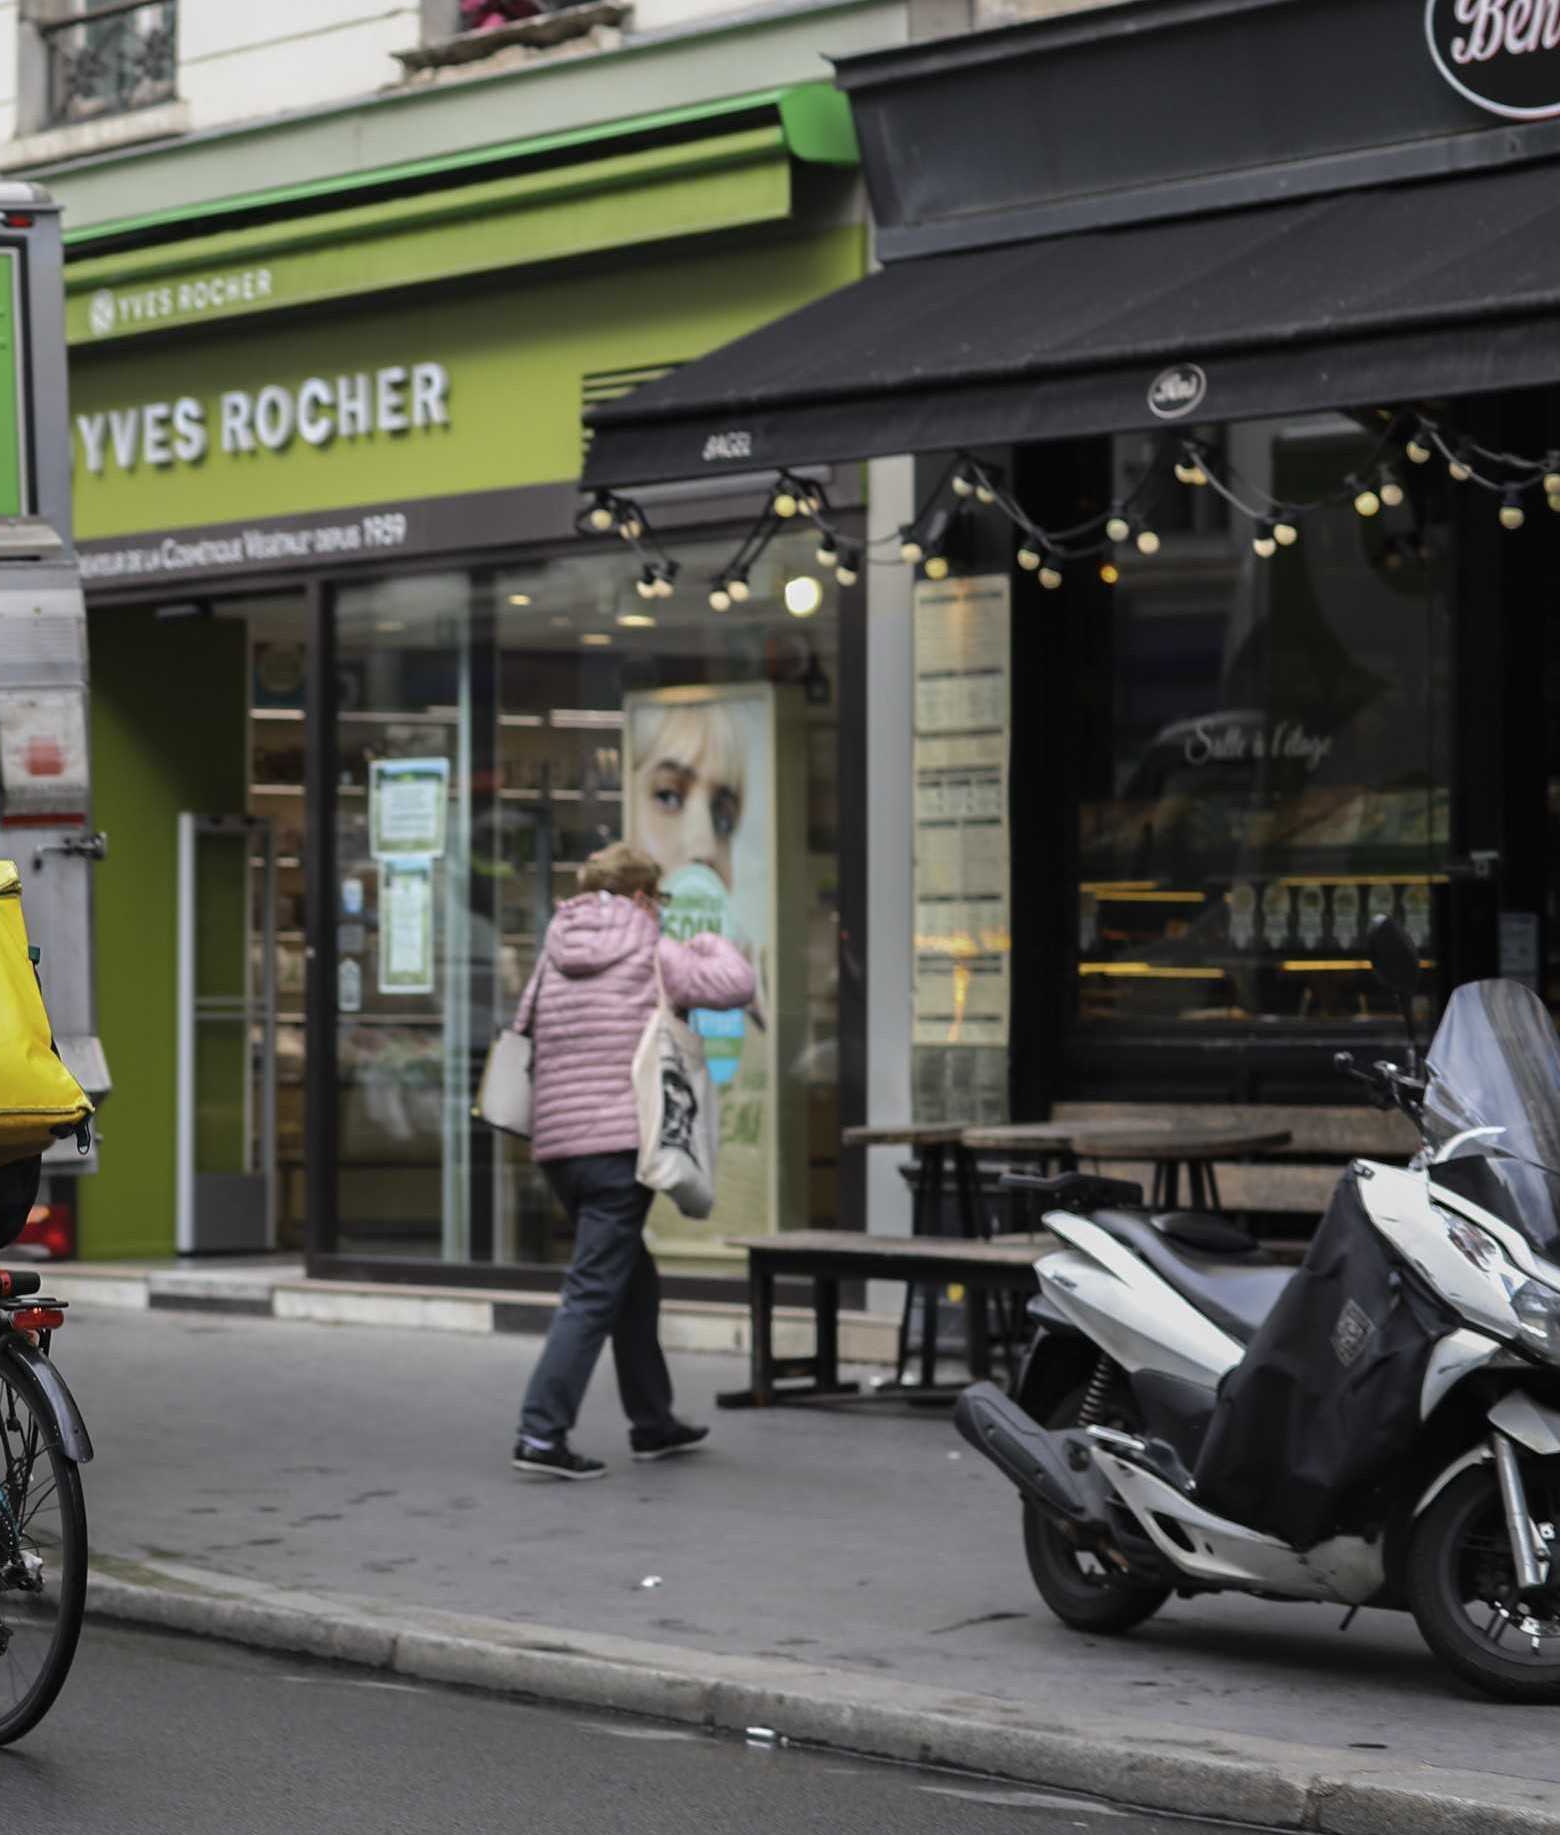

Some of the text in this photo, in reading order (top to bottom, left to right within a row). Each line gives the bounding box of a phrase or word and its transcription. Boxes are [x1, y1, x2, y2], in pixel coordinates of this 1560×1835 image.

[118, 269, 273, 322] YVES ROCHER
[76, 361, 451, 472] YVES ROCHER
